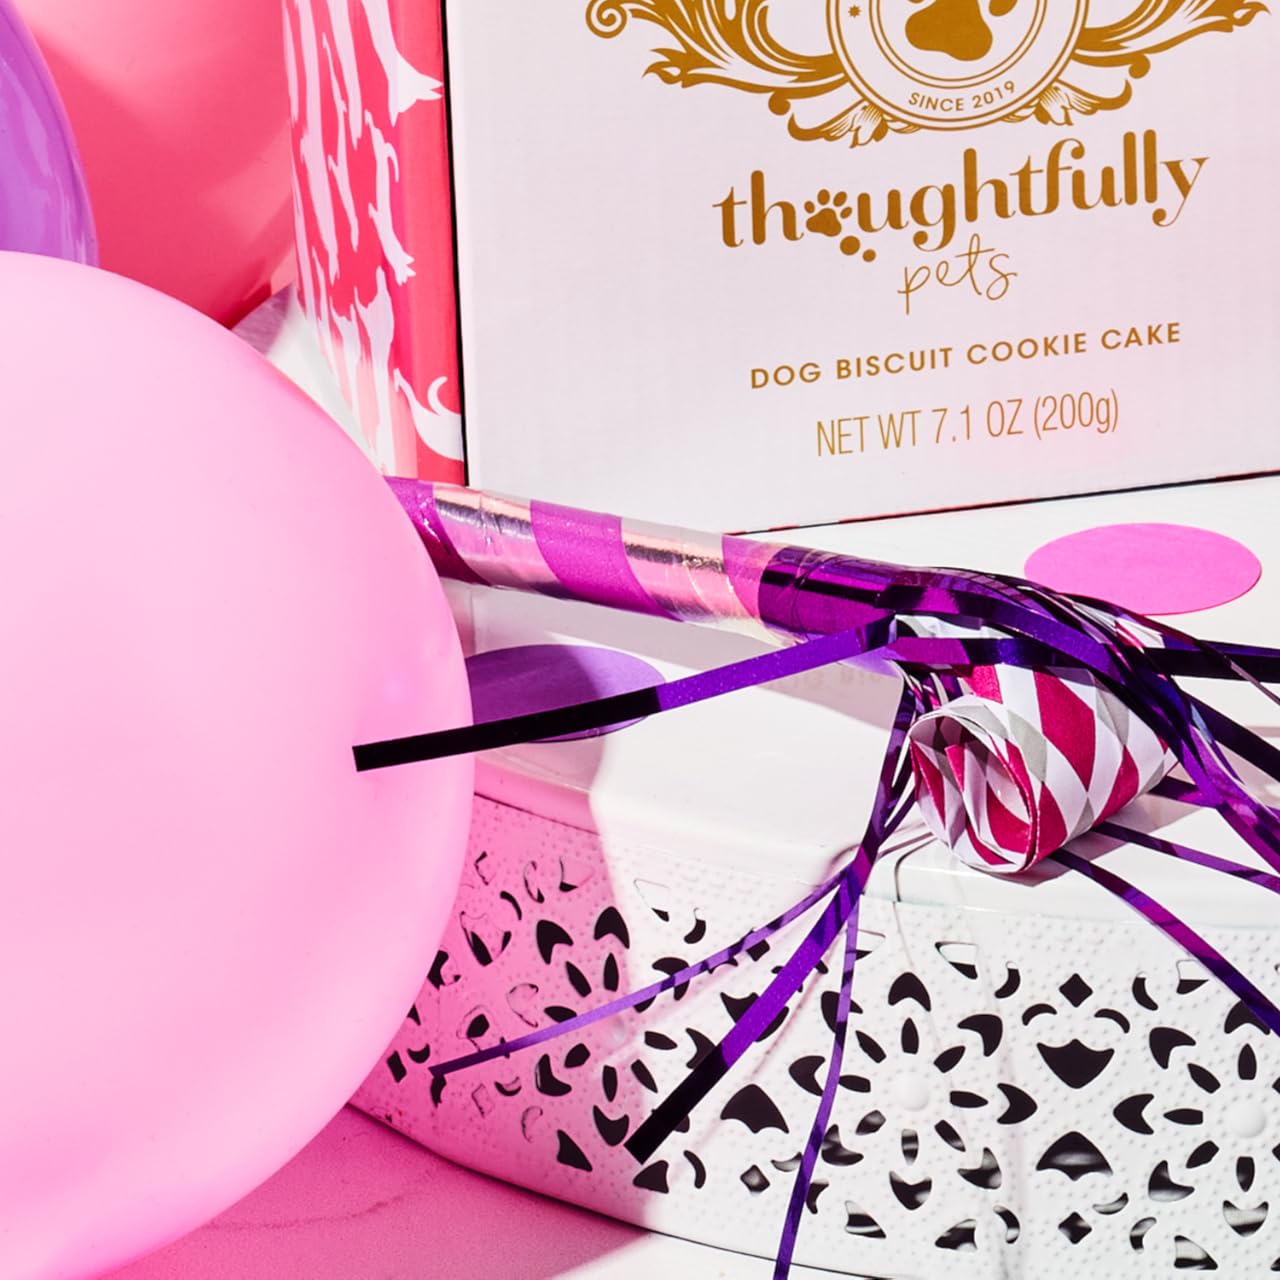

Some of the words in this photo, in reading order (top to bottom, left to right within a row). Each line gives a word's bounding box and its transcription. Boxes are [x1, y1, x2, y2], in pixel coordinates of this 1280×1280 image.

[907, 90, 965, 113] SINCE
[972, 80, 1016, 110] 2019
[897, 232, 1019, 315] pets
[750, 361, 822, 391] DOG
[835, 346, 953, 381] BISCUIT
[966, 331, 1088, 366] COOKIE
[1100, 321, 1181, 351] CAKE
[816, 415, 870, 457] NET
[878, 409, 922, 449] WT
[932, 405, 971, 444] 7.1
[985, 398, 1025, 438] OZ
[1033, 389, 1120, 440] (200g)
